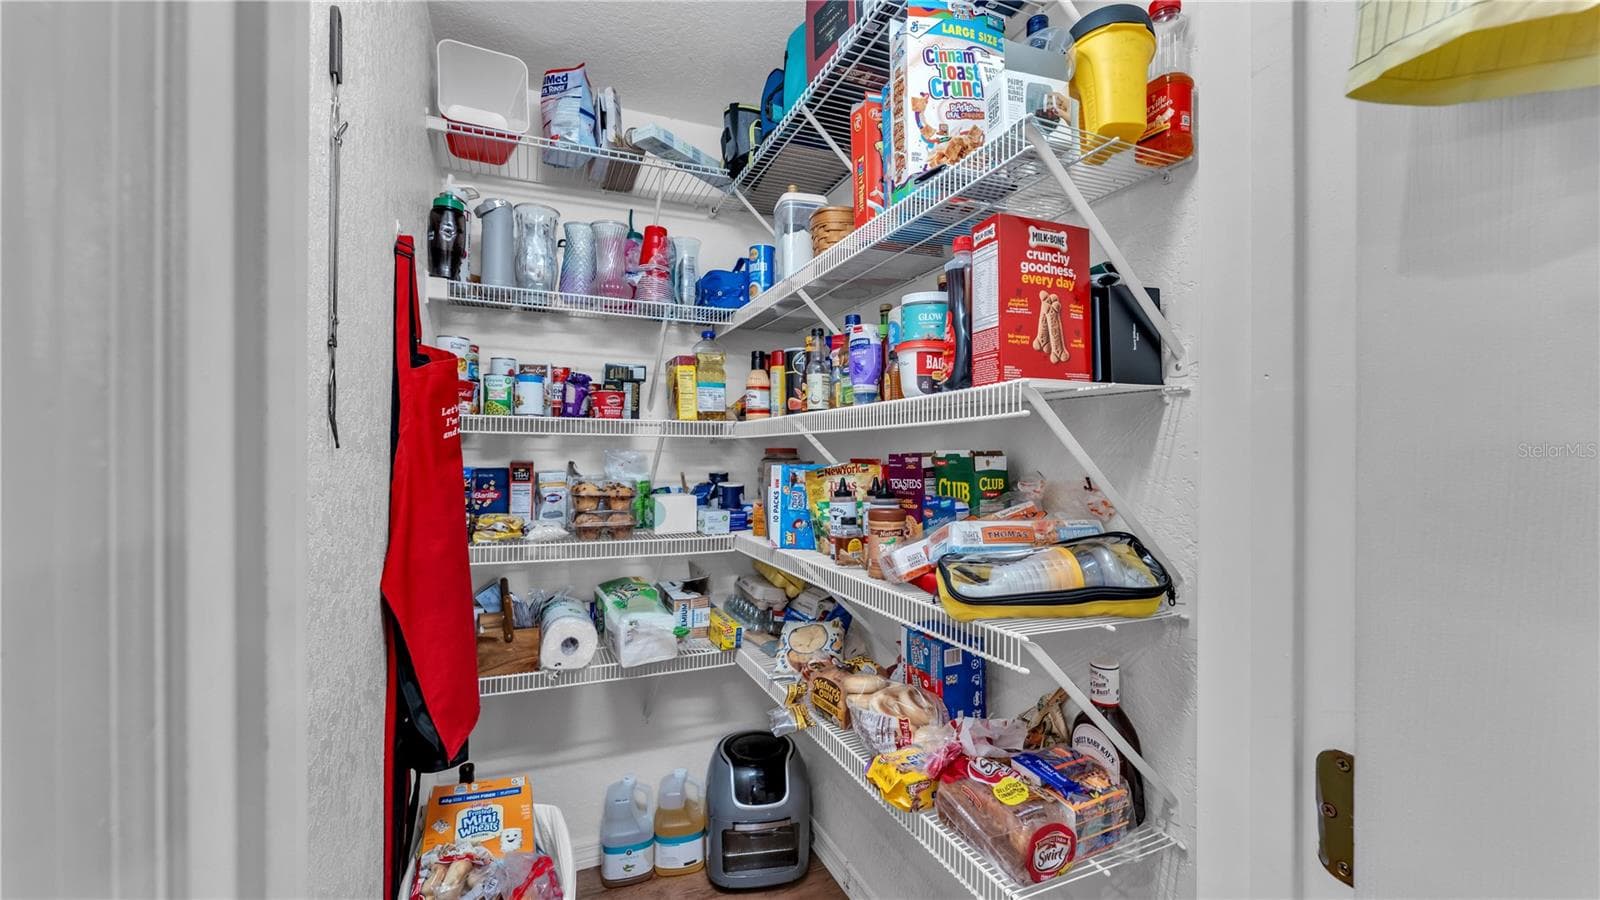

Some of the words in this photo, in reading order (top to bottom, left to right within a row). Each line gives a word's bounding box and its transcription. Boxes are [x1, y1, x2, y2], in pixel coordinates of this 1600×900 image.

[941, 22, 976, 40] LARGE
[978, 31, 999, 47] SIZE
[925, 44, 977, 64] Cinnam
[939, 63, 981, 81] Toast
[931, 77, 982, 98] Crunc
[1026, 249, 1070, 267] crunchy
[1020, 261, 1077, 281] goodness,
[1021, 273, 1054, 289] every
[1055, 276, 1075, 292] day
[917, 312, 944, 322] GLOW
[889, 478, 922, 491] TOASTEDS
[938, 478, 971, 503] CLUB
[978, 476, 1005, 492] CLUB
[473, 490, 500, 500] Barilla
[772, 490, 780, 513] PACKS
[681, 603, 689, 627] EMIUM
[462, 812, 498, 829] Mini
[468, 807, 493, 817] Frosted
[459, 821, 499, 838] Wheats
[1037, 847, 1064, 868] Swirl
